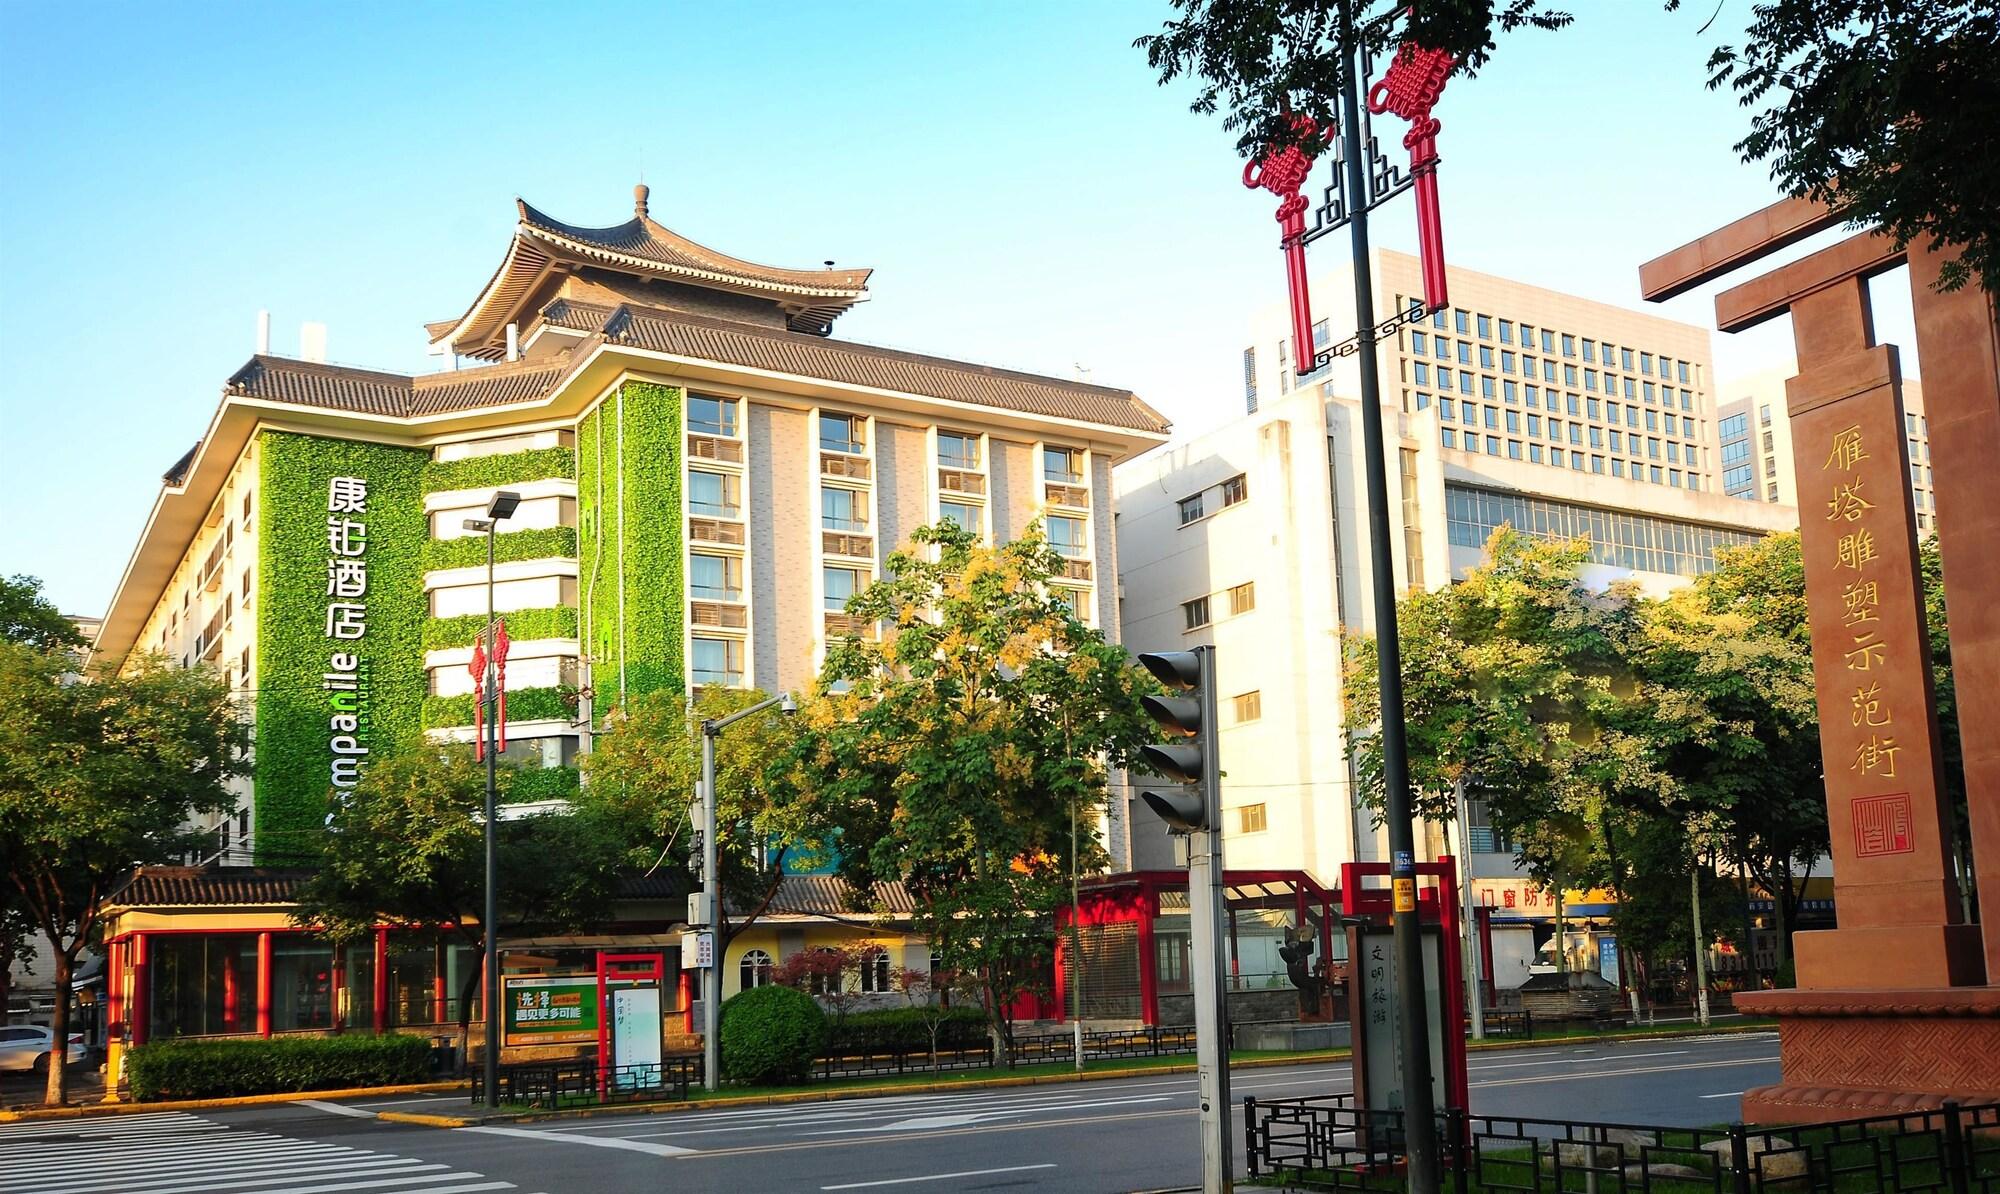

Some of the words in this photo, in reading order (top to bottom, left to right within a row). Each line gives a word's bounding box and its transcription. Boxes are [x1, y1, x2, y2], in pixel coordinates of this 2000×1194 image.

[324, 476, 367, 640] 康铂酒店
[1823, 423, 1902, 778] 雁塔雕塑示范街
[359, 656, 369, 741] RESTAURANT
[515, 1007, 582, 1021] 遇见更多可能
[1370, 945, 1387, 1025] 文明旅游
